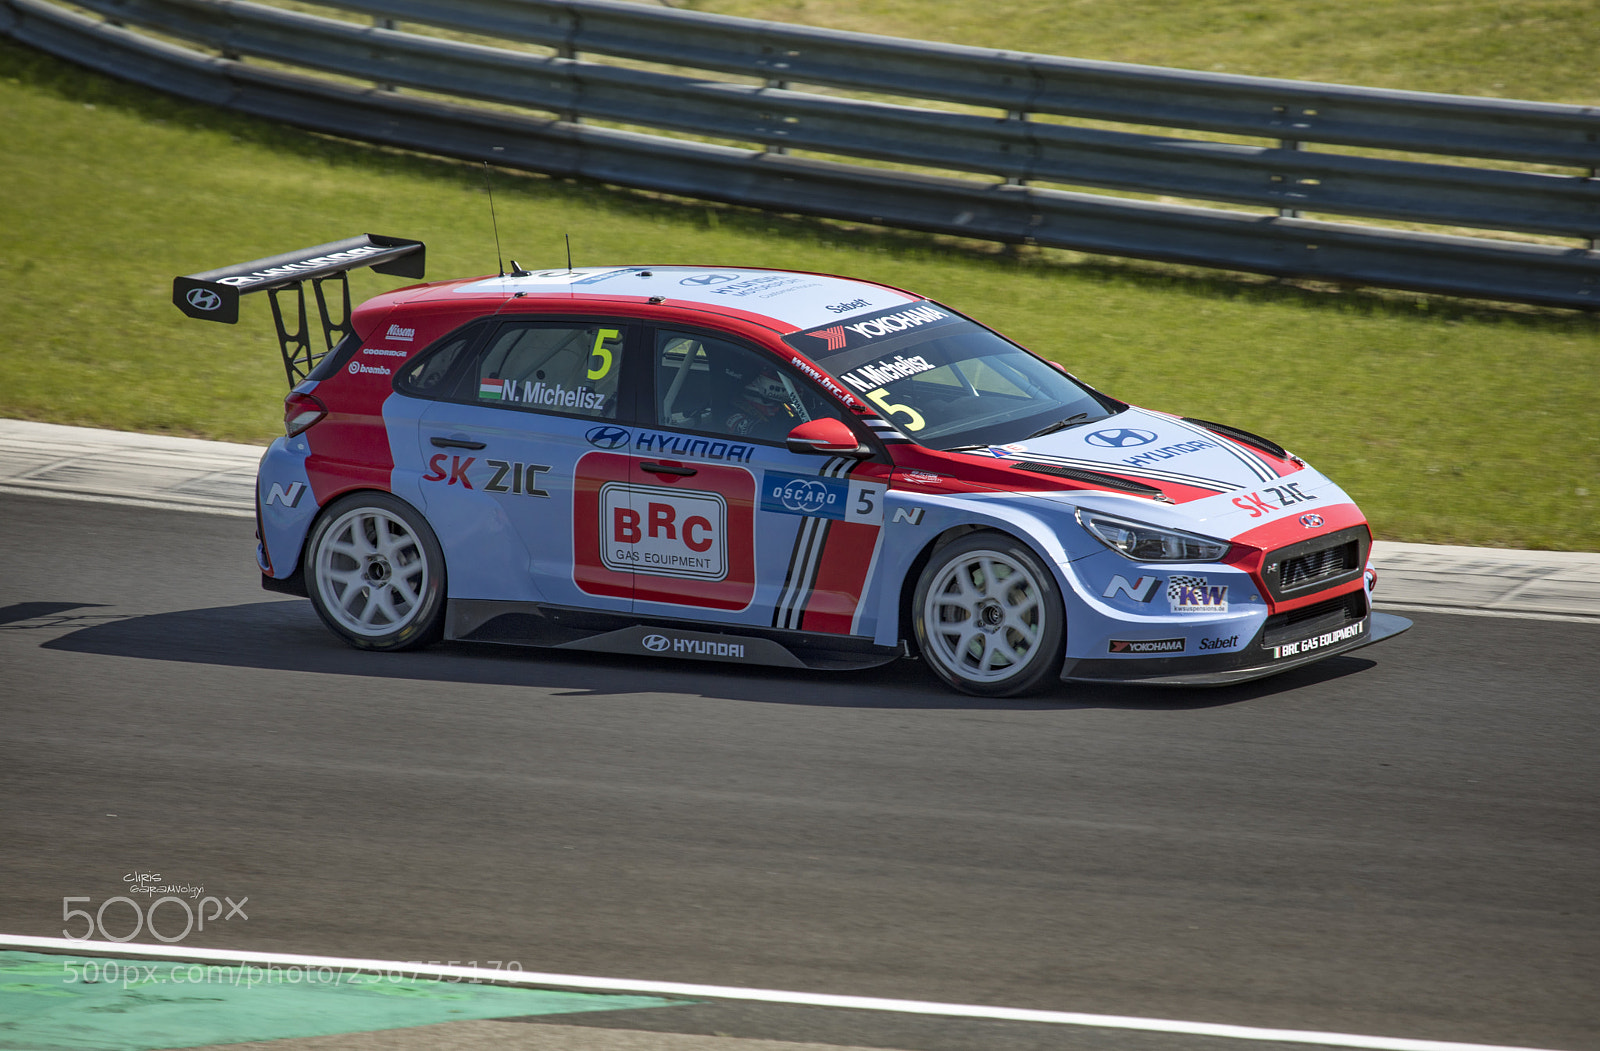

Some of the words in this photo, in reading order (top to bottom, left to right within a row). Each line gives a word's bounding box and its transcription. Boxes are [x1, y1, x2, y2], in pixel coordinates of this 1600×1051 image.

[825, 298, 872, 314] Sabelt
[845, 305, 949, 339] YOKOHAMA
[363, 348, 407, 357] GOODRIDGE
[587, 328, 619, 380] 5
[359, 364, 391, 375] brembo
[791, 356, 855, 407] www.brc.it
[502, 379, 519, 402] N.
[522, 380, 605, 410] Michelisz
[865, 387, 926, 431] 5
[635, 432, 755, 464] HYUNDAI
[1122, 439, 1218, 467] HYUNDAI
[422, 453, 476, 490] SK
[484, 459, 553, 498] ZIC
[772, 487, 836, 504] OSCARO
[856, 488, 876, 515] 5
[1231, 492, 1280, 518] SK
[613, 501, 713, 553] BRC
[616, 549, 640, 562] GAS
[644, 553, 711, 569] EQUIPMENT
[1173, 605, 1226, 613] kwsuspensions.de
[1178, 585, 1228, 606] KW
[673, 638, 745, 658] HYUNDAI
[1129, 641, 1183, 651] YOKOHAMA
[1199, 635, 1239, 650] Sabelt
[1282, 642, 1300, 658] BRC
[1301, 637, 1319, 653] GAS
[1319, 623, 1359, 647] EQUIPMENT
